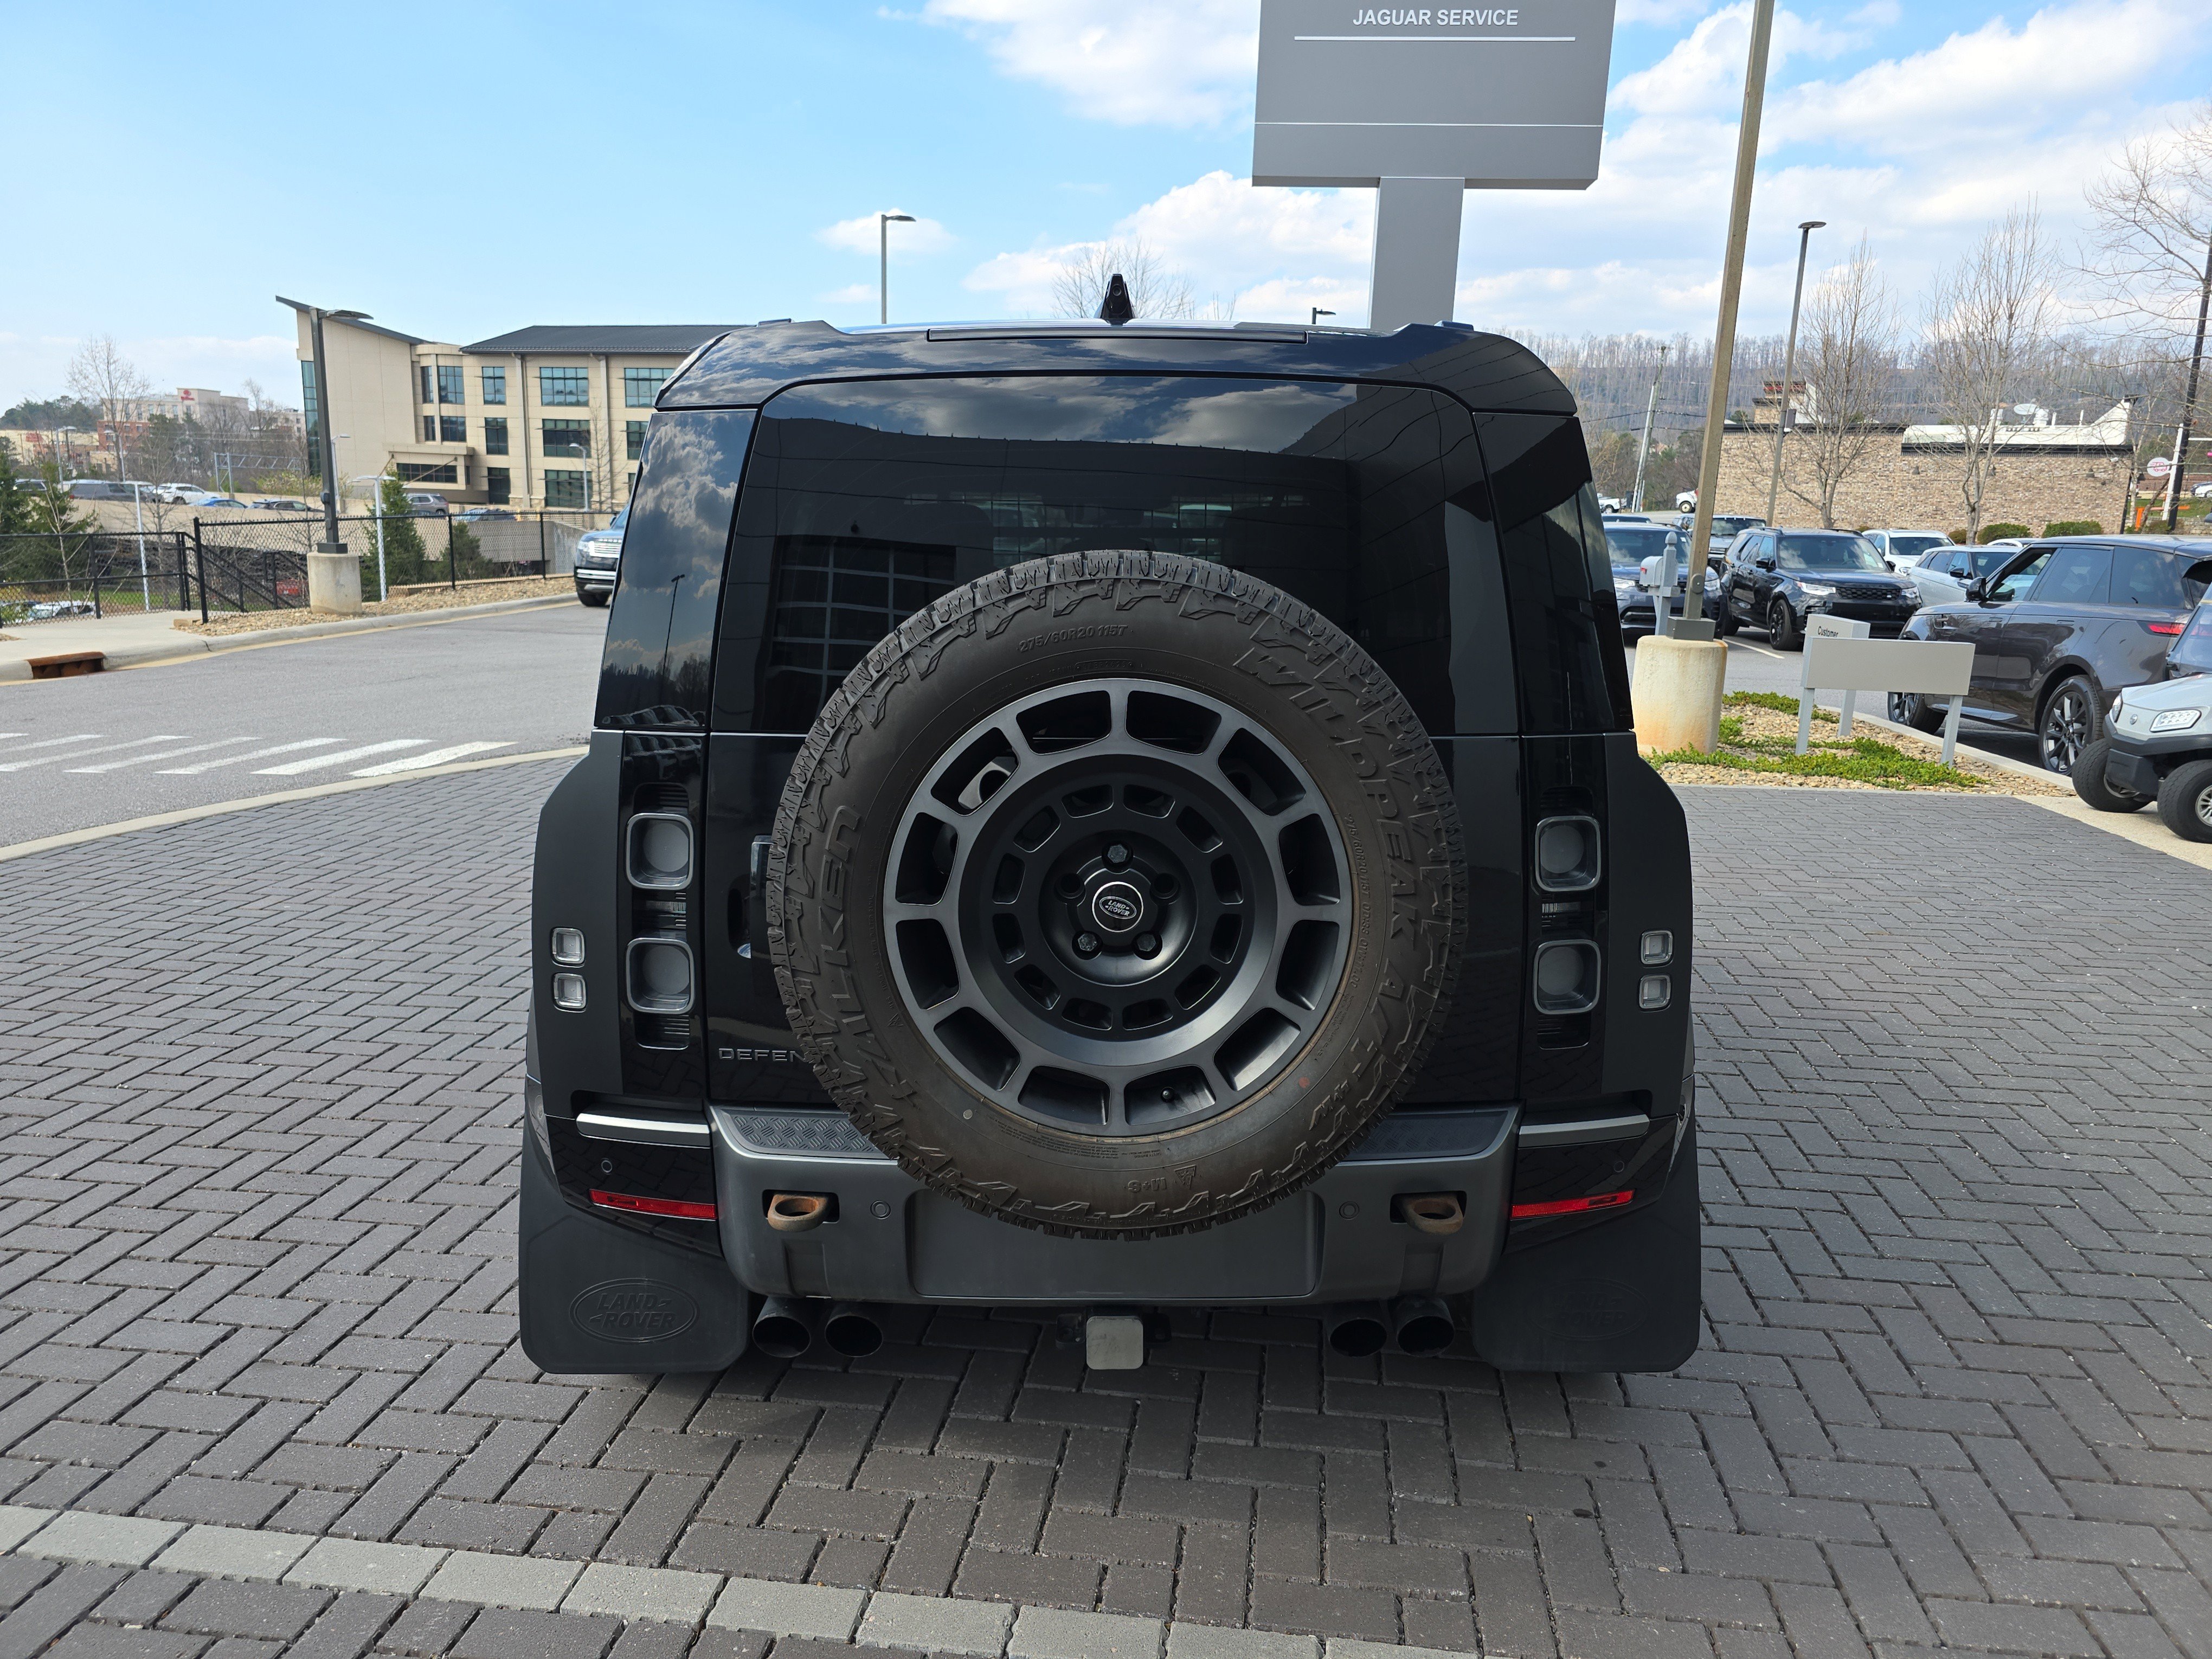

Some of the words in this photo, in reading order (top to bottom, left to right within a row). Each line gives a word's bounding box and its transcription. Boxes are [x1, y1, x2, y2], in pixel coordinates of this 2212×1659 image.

[1352, 9, 1431, 26] JAGUAR
[1437, 9, 1519, 26] SERVICE
[1019, 625, 1095, 652] 275/60R20
[1098, 625, 1128, 636] 115T
[1817, 626, 1839, 638] Customer
[1232, 647, 1418, 949] WILDPEAK
[1108, 900, 1127, 910] LAND
[1108, 905, 1130, 916] ROVER
[818, 805, 917, 1100] FALKEN
[1128, 1177, 1167, 1193] M+S
[597, 1293, 658, 1310] LAND
[601, 1311, 677, 1329] ROVER
